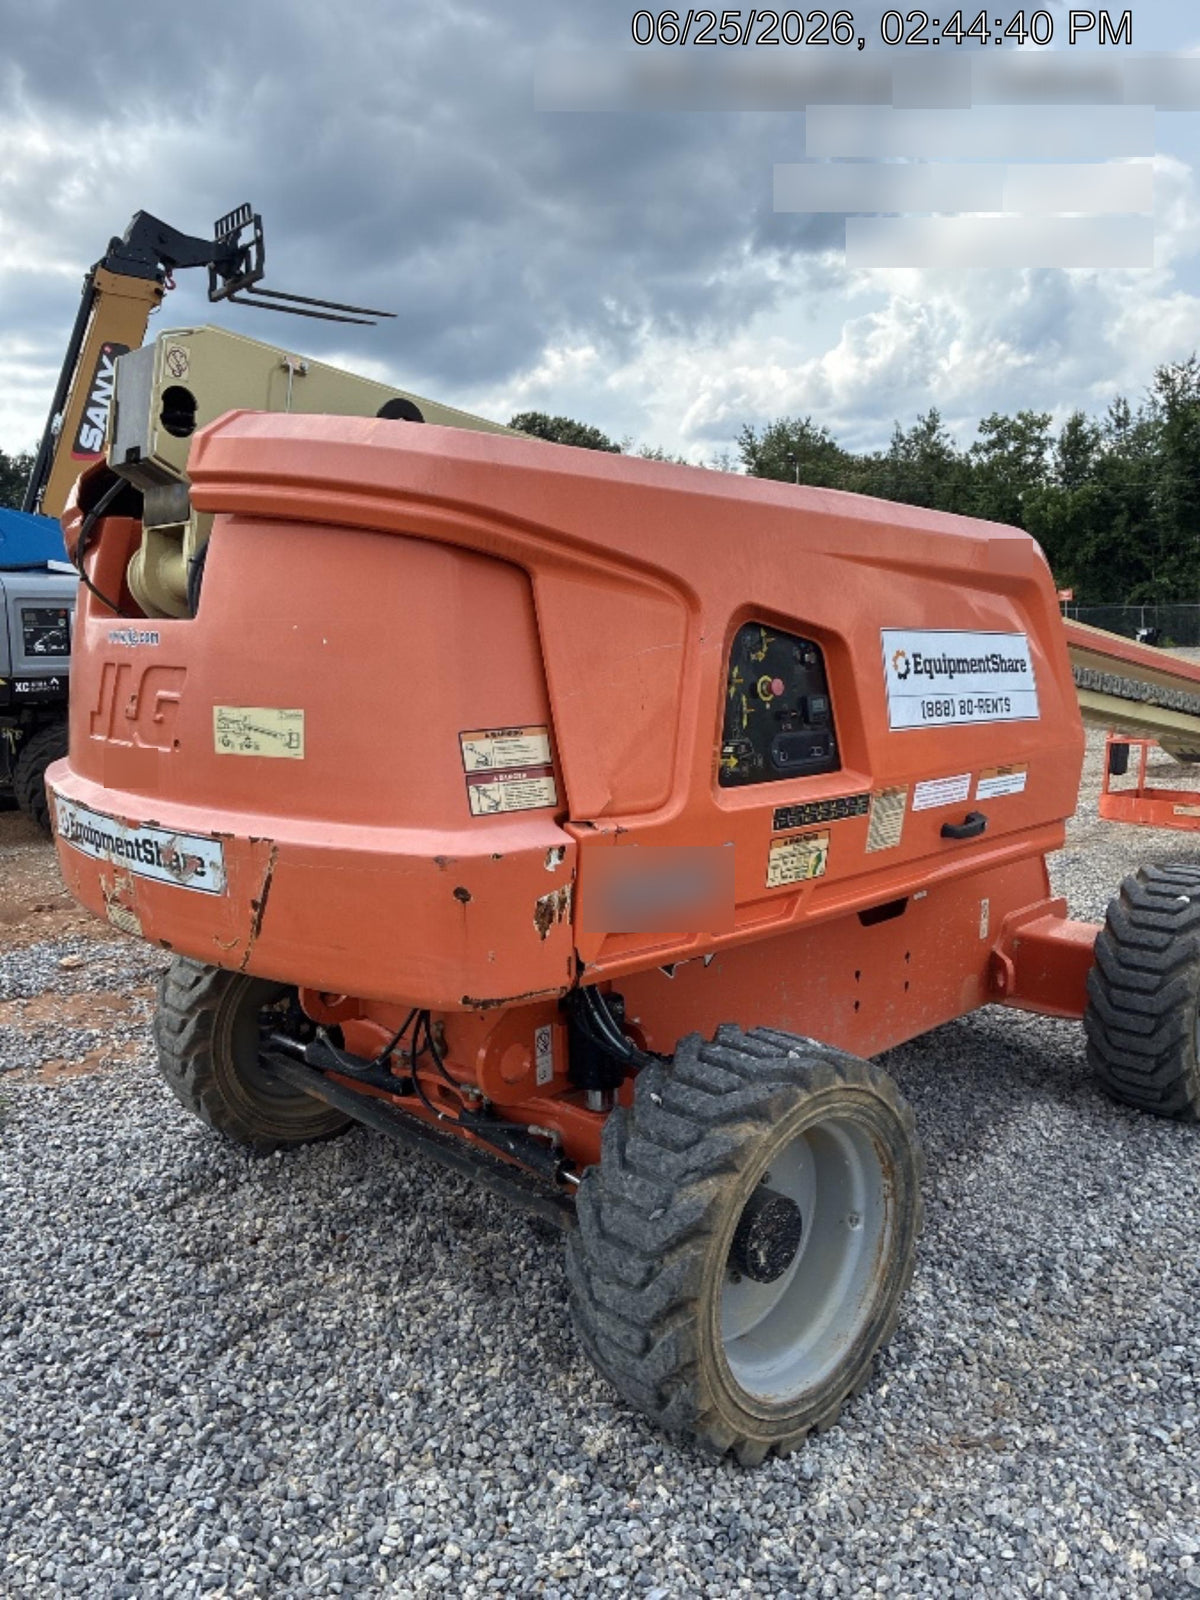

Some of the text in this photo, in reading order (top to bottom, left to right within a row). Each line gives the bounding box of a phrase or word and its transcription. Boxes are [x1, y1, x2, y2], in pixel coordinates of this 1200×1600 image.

[79, 354, 115, 452] SANY
[911, 652, 1027, 680] EquipmentShare
[15, 681, 29, 692] XC
[89, 662, 188, 752] JLG
[921, 697, 1011, 719] (888) 80-RENTS
